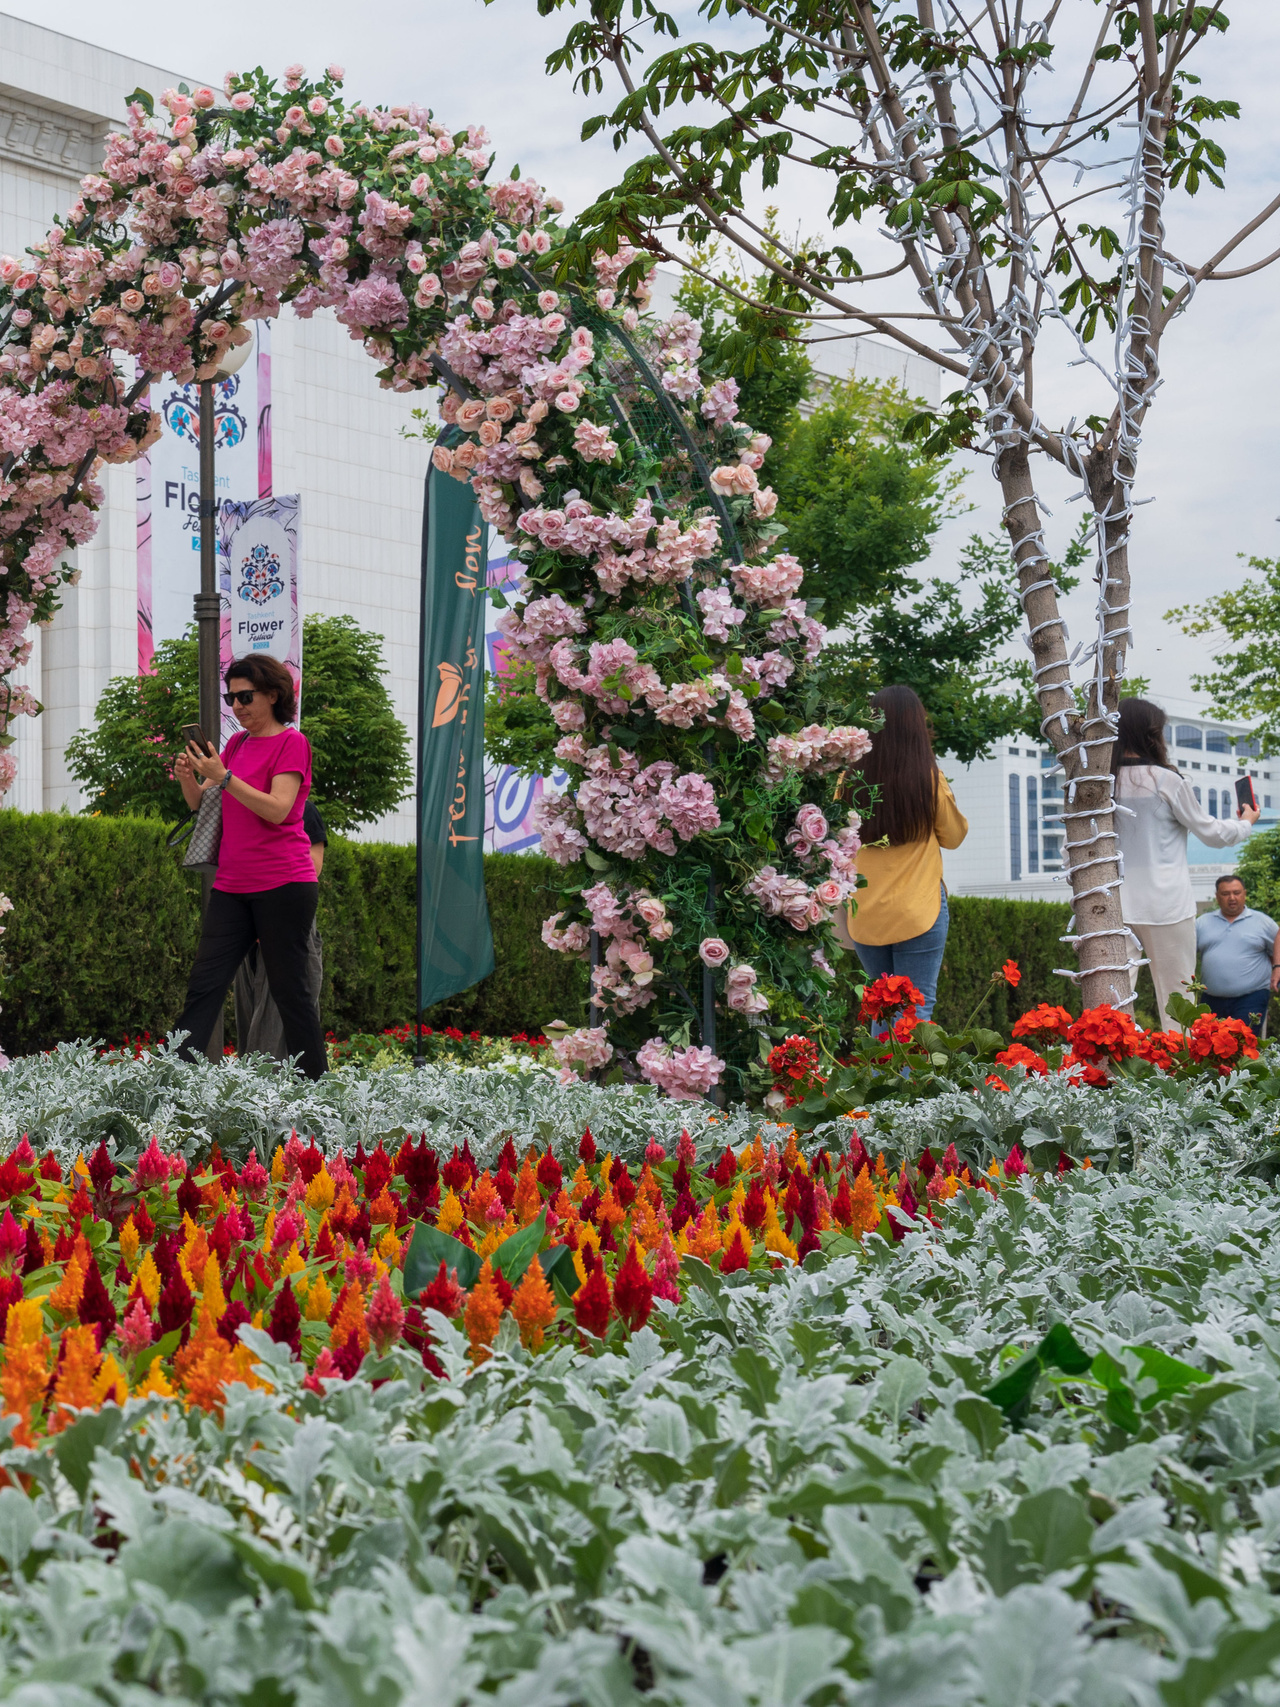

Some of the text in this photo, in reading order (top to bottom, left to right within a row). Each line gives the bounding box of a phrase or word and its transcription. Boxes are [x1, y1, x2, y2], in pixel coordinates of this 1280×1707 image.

[181, 466, 230, 488] Tasent
[238, 620, 284, 635] Flower
[248, 631, 275, 642] Festival
